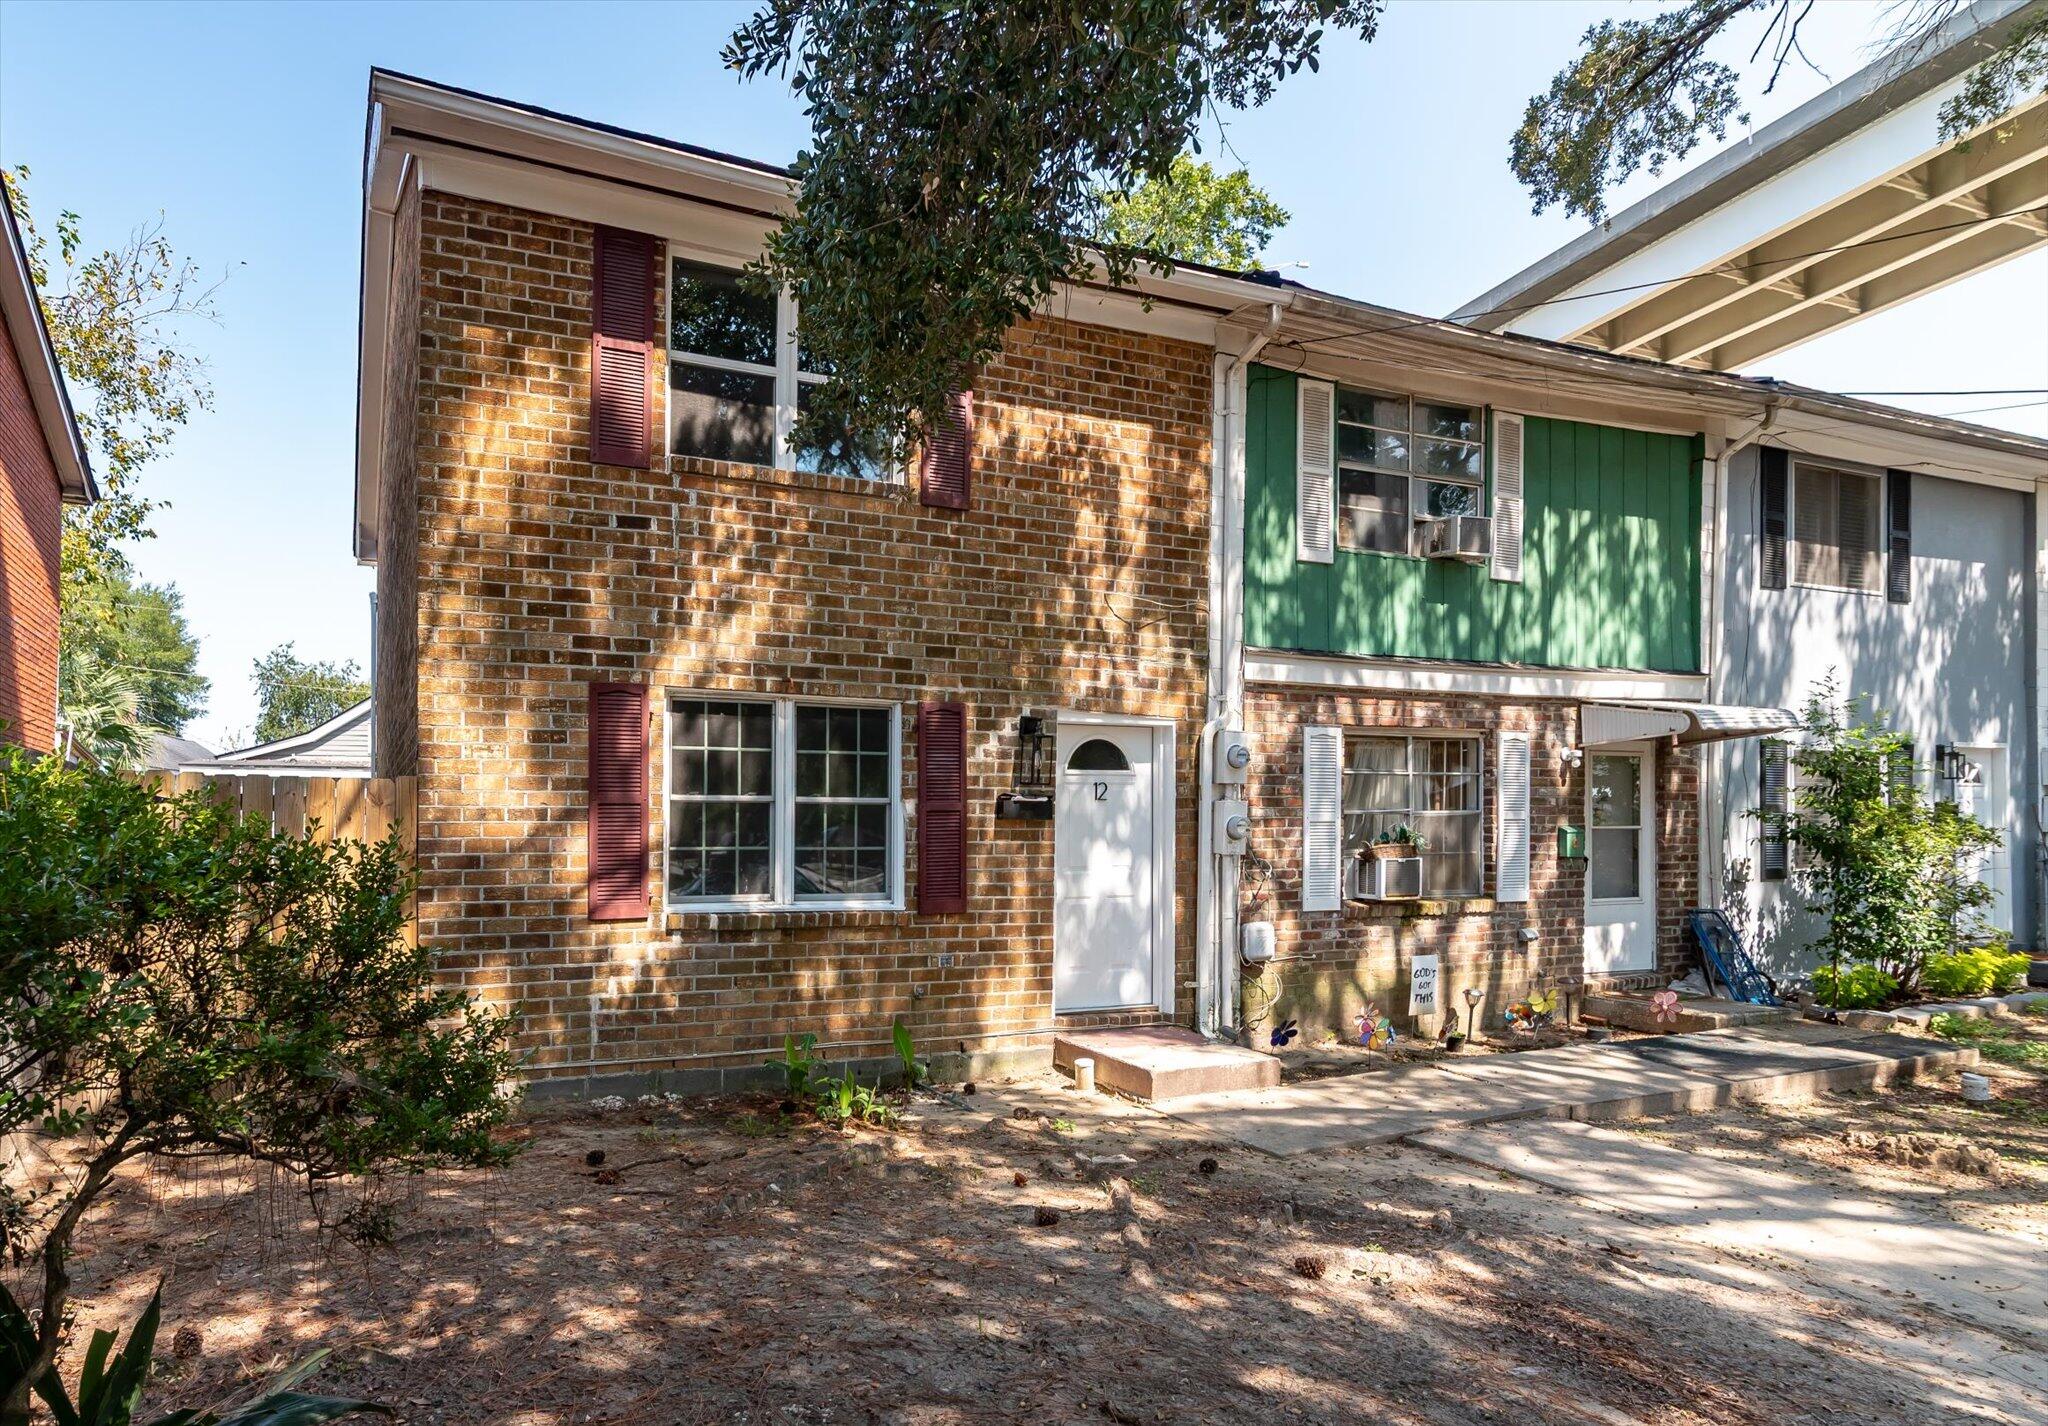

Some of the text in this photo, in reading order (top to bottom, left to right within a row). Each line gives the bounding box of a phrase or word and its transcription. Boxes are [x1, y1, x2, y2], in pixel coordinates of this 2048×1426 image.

[1093, 781, 1108, 801] 12
[1418, 981, 1431, 990] GOT
[1414, 991, 1434, 1004] THIS
